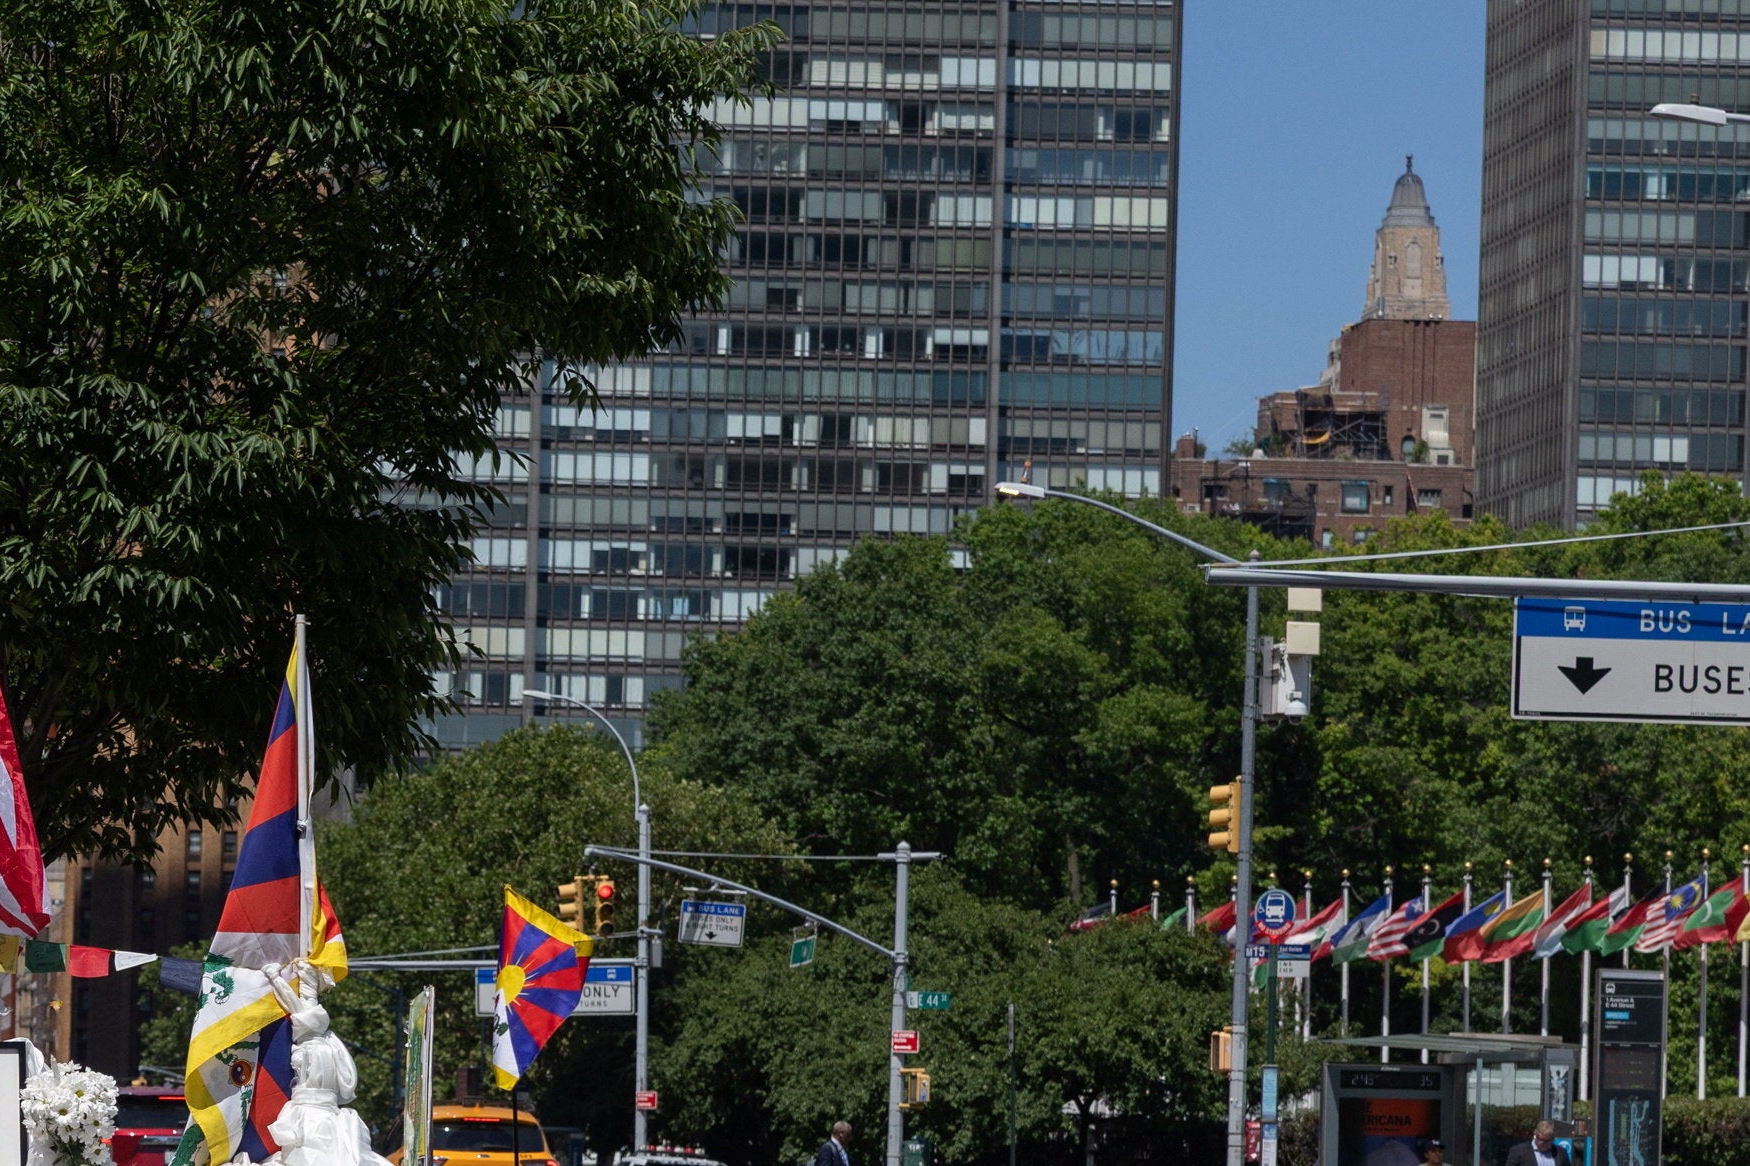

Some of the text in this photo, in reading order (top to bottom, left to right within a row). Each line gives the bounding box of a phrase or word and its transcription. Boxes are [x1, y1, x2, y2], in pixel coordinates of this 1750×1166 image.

[1640, 609, 1691, 633] BUS
[1654, 664, 1750, 695] BUSE
[717, 907, 740, 915] LANE
[715, 916, 734, 924] ONLY
[715, 924, 739, 932] TURNS
[1246, 946, 1266, 957] M15
[583, 985, 620, 998] ONLY
[918, 994, 924, 1007] E
[926, 994, 939, 1007] 44
